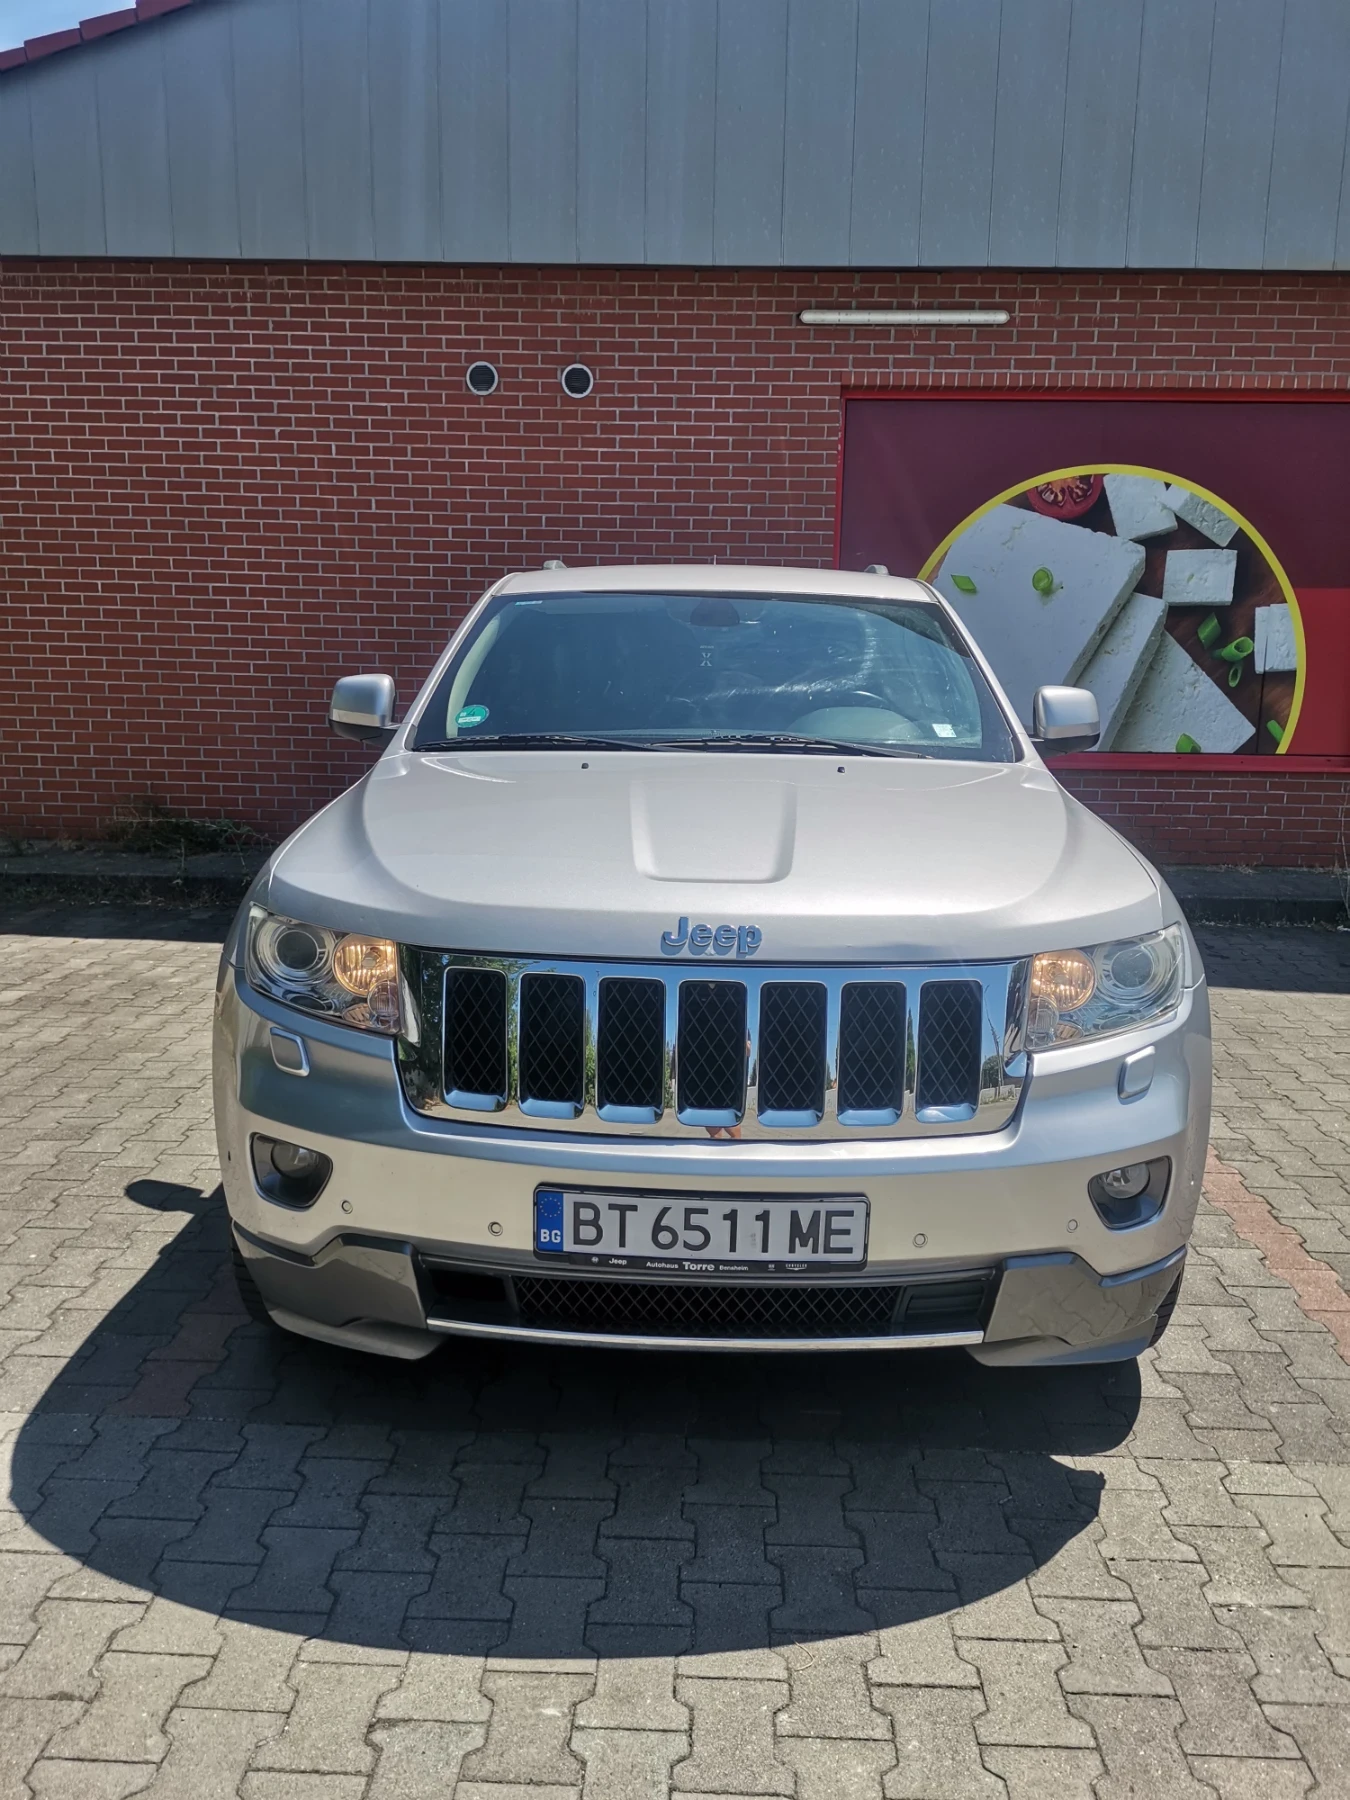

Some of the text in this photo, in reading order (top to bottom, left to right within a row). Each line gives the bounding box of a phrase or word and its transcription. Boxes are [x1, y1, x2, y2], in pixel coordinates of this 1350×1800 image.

[660, 916, 762, 956] Jeep
[573, 1201, 855, 1254] BT 6511 ME
[540, 1229, 561, 1243] BG
[608, 1257, 627, 1266] Jeep
[646, 1261, 679, 1269] Autohaus
[682, 1261, 715, 1271] Torre
